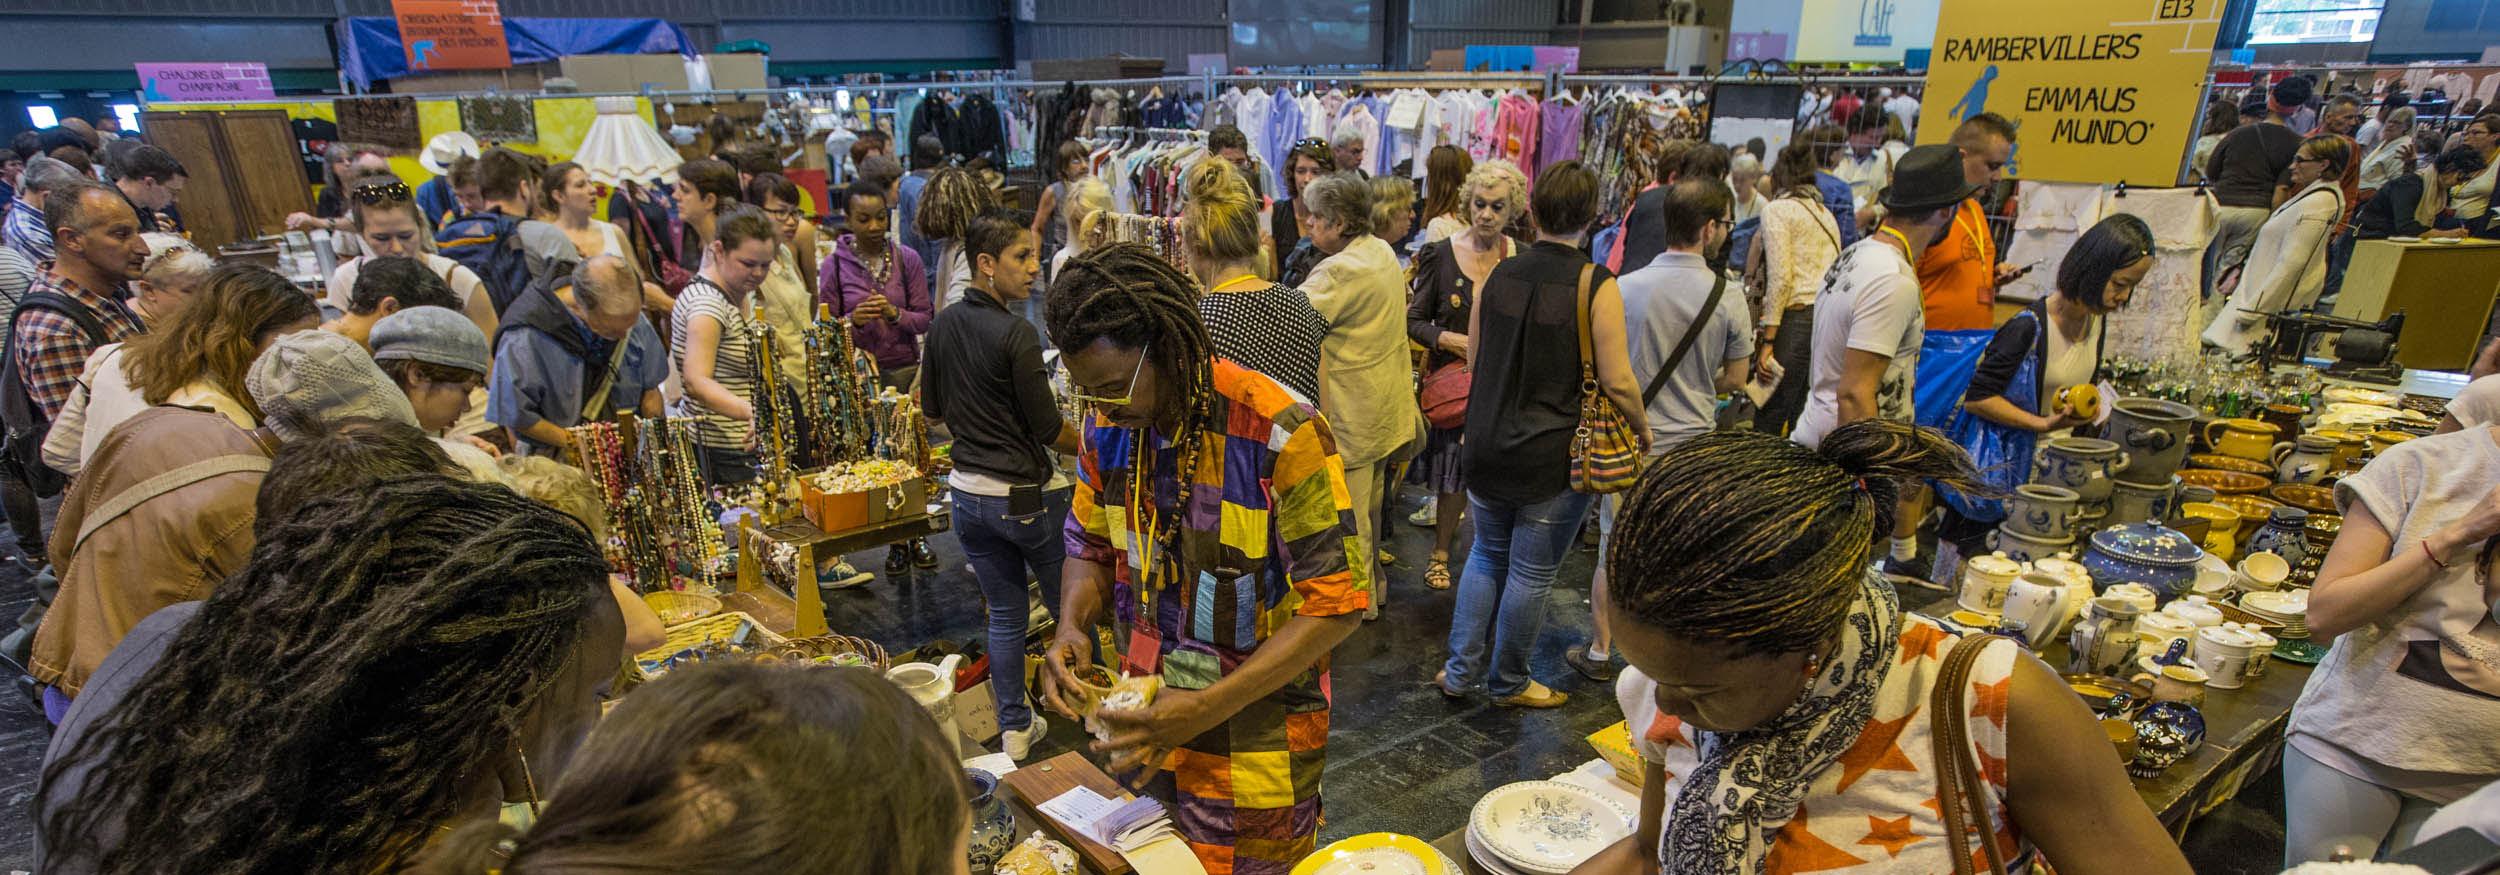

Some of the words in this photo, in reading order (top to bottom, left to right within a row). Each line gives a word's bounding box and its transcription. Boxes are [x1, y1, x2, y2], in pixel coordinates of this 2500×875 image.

[2159, 0, 2194, 19] E13
[1944, 33, 2142, 62] RAMBERVILLERS
[210, 70, 225, 80] EN
[178, 82, 242, 92] CHAMPAGNE
[2025, 87, 2137, 112] EMMAUS
